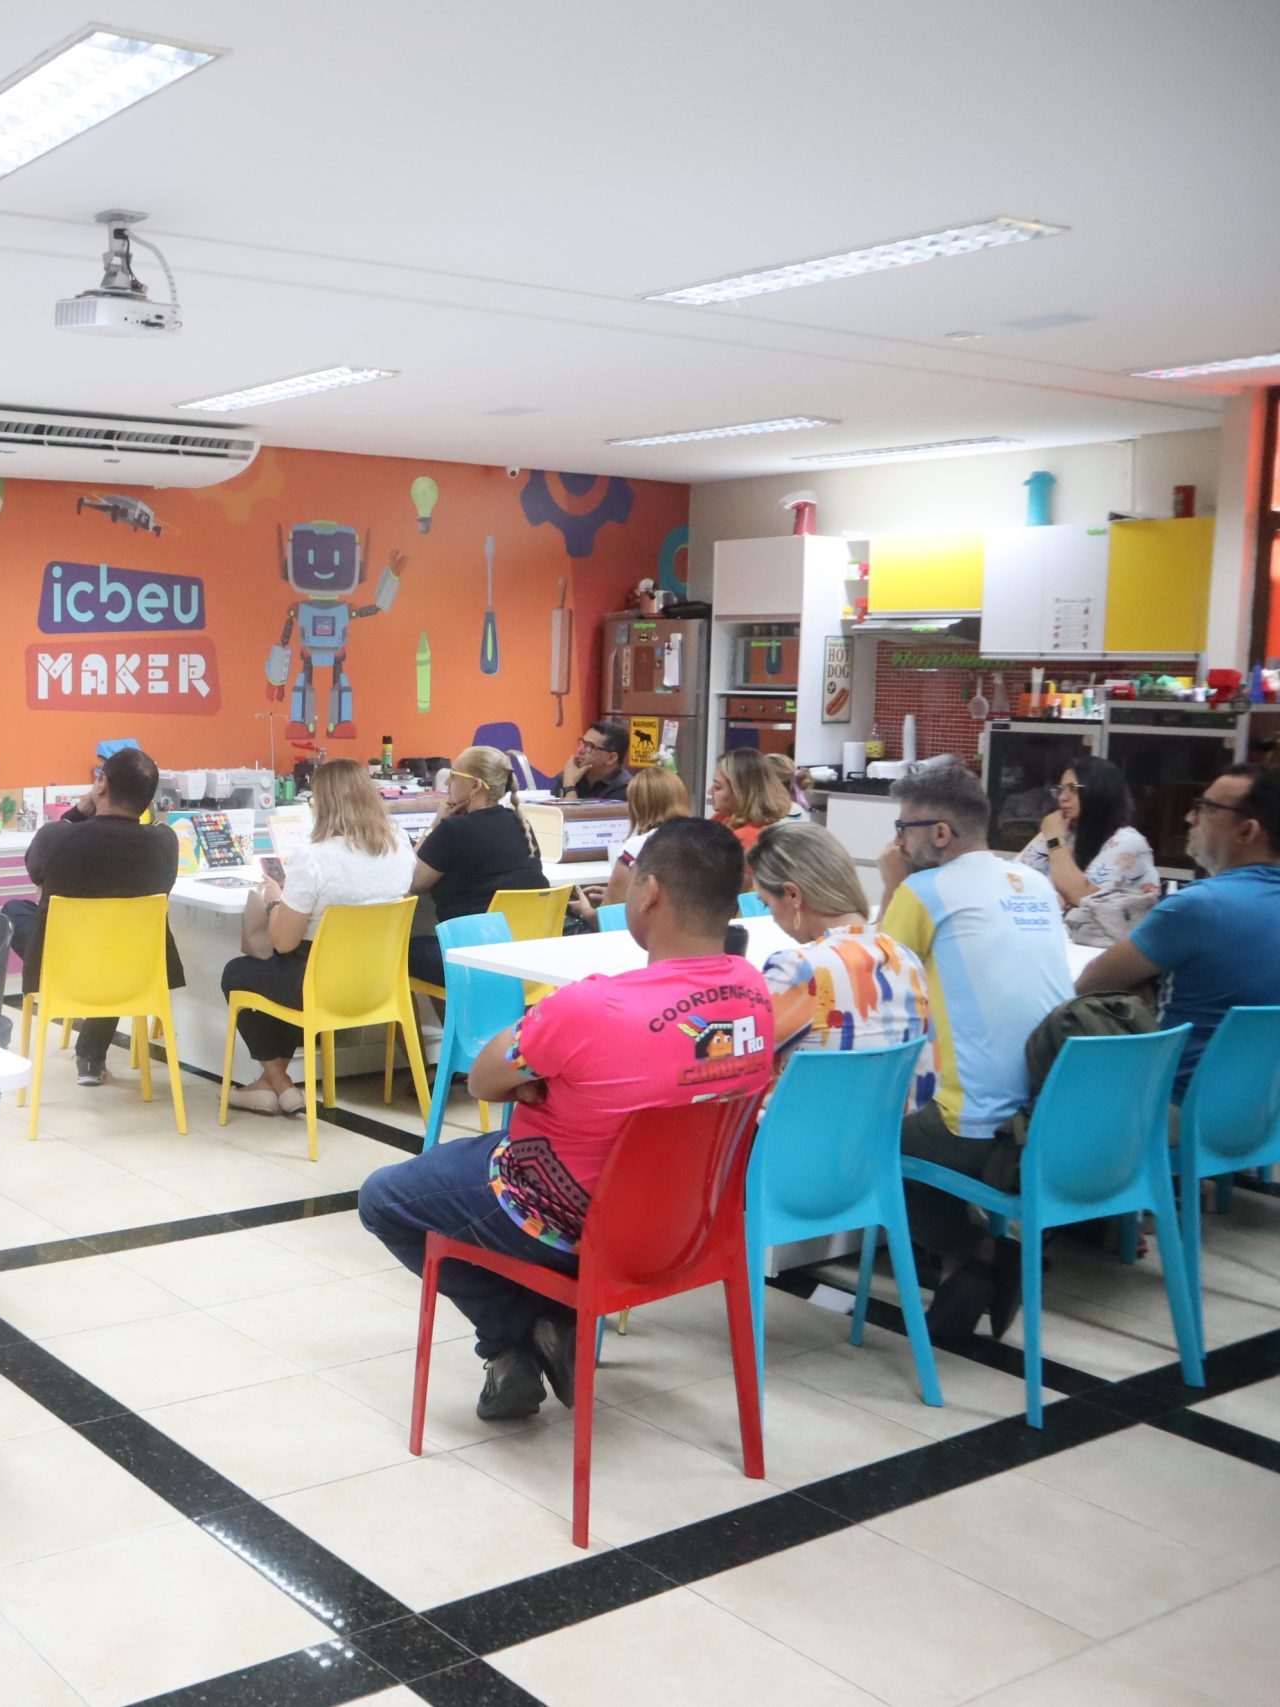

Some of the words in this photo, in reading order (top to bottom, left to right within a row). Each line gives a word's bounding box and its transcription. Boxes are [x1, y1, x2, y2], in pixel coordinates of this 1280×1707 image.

[52, 563, 199, 624] icbeu
[827, 648, 850, 662] HOT
[37, 653, 211, 700] MAKER
[827, 664, 850, 678] DOG
[632, 720, 657, 728] WARNING
[999, 899, 1051, 913] Manaus
[648, 984, 773, 1033] COORDENAÇÃO
